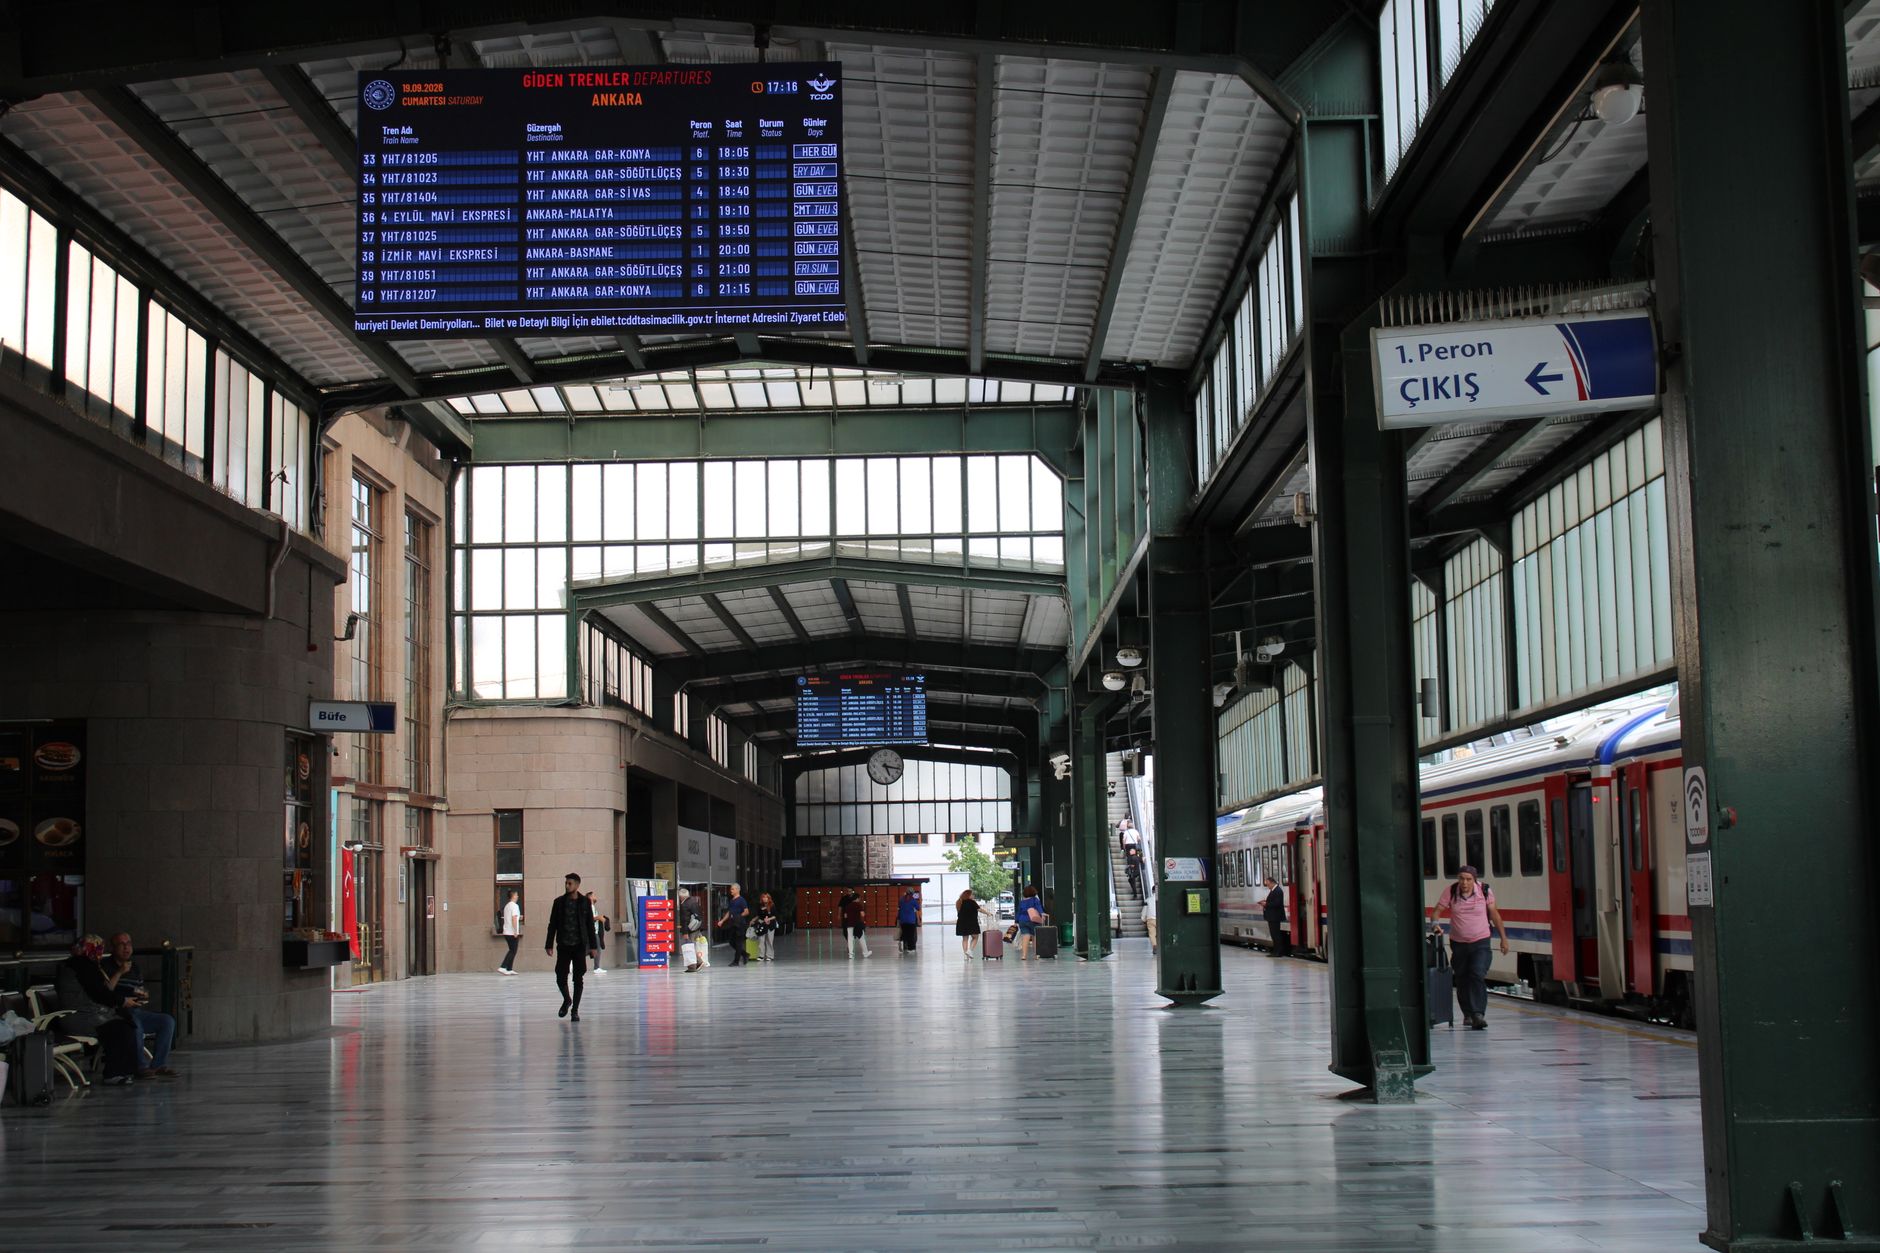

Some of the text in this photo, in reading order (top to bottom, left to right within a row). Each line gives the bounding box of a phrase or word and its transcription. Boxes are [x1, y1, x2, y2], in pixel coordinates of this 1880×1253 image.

[523, 70, 712, 87] GİDEN TRENLER DEPARTURES
[402, 83, 443, 93] 19.09.2026
[767, 81, 798, 92] 17:16
[448, 96, 484, 105] SATURDAY
[592, 93, 643, 106] ANKARA
[690, 120, 712, 130] Peron
[725, 119, 742, 129] Saat
[759, 119, 784, 128] Durum
[803, 117, 828, 127] Günler
[382, 126, 413, 135] Tren Adı
[526, 123, 562, 134] Güzergah
[726, 129, 743, 138] Time
[761, 129, 782, 137] Status
[807, 128, 823, 137] Days
[382, 136, 419, 144] Train Name
[526, 133, 563, 142] Destination
[526, 149, 651, 161] YHT ANKARA GAR-KONYA
[696, 148, 703, 158] 6
[719, 147, 749, 158] 18:05
[802, 147, 821, 157] HER
[363, 154, 376, 165] 33
[382, 153, 438, 164] YHT/81205
[526, 170, 545, 180] YHT
[551, 170, 589, 180] ANKARA
[696, 168, 703, 178] 5
[719, 167, 749, 177] 18:30
[810, 166, 825, 176] DAY
[363, 174, 376, 184] 34
[382, 172, 438, 183] YHT/81023
[526, 186, 651, 200] YHT ANKARA GAR-SİVAS
[696, 187, 703, 197] 4
[719, 186, 749, 197] 18:40
[796, 183, 814, 196] GÜN
[363, 193, 375, 203] 35
[381, 192, 437, 203] YHT/81404
[381, 208, 512, 222] 4 EYLÜL MAVİ EKSPRESİ
[526, 208, 614, 220] ANKARA-MALATYA
[697, 206, 702, 216] 1
[719, 205, 750, 216] 19:10
[813, 205, 830, 215] THU
[363, 213, 375, 223] 36
[526, 229, 545, 239] YHT
[551, 228, 589, 238] ANKARA
[697, 226, 703, 236] 5
[719, 225, 750, 236] 19:50
[796, 223, 815, 235] GÜN
[362, 232, 374, 242] 37
[381, 231, 437, 242] YHT/81025
[526, 247, 614, 259] ANKARA-BASMANE
[697, 245, 703, 255] 1
[719, 244, 750, 255] 20:00
[797, 242, 815, 254] GÜN
[362, 252, 374, 261] 38
[381, 247, 499, 261] İZMİR MAVİ EKSPRESİ
[526, 268, 545, 278] YHT
[551, 267, 589, 278] ANKARA
[697, 264, 703, 275] 5
[719, 264, 750, 275] 21:00
[796, 263, 828, 274] FRI SUN
[361, 271, 374, 281] 39
[380, 270, 437, 281] YHT/81051
[526, 285, 652, 298] YHT ANKARA GAR-KONYA
[697, 284, 703, 294] 6
[719, 283, 751, 294] 21:15
[797, 282, 816, 293] GÜN
[361, 290, 374, 301] 40
[380, 289, 437, 300] YHT/81207
[390, 319, 418, 330] Devlet
[485, 317, 505, 328] Bilet
[506, 319, 517, 328] ve
[519, 316, 550, 330] Detaylı
[551, 316, 571, 329] Bilgi
[572, 313, 589, 329] İçin
[591, 313, 713, 327] ebilet.tcddtasimacilik.gov.tr
[715, 311, 750, 324] İnternet
[752, 312, 788, 323] Adresini
[790, 311, 821, 325] Ziyaret
[1395, 341, 1493, 364] 1. Peron
[1400, 372, 1480, 408] ÇIKIŞ
[319, 711, 347, 722] Büfe
